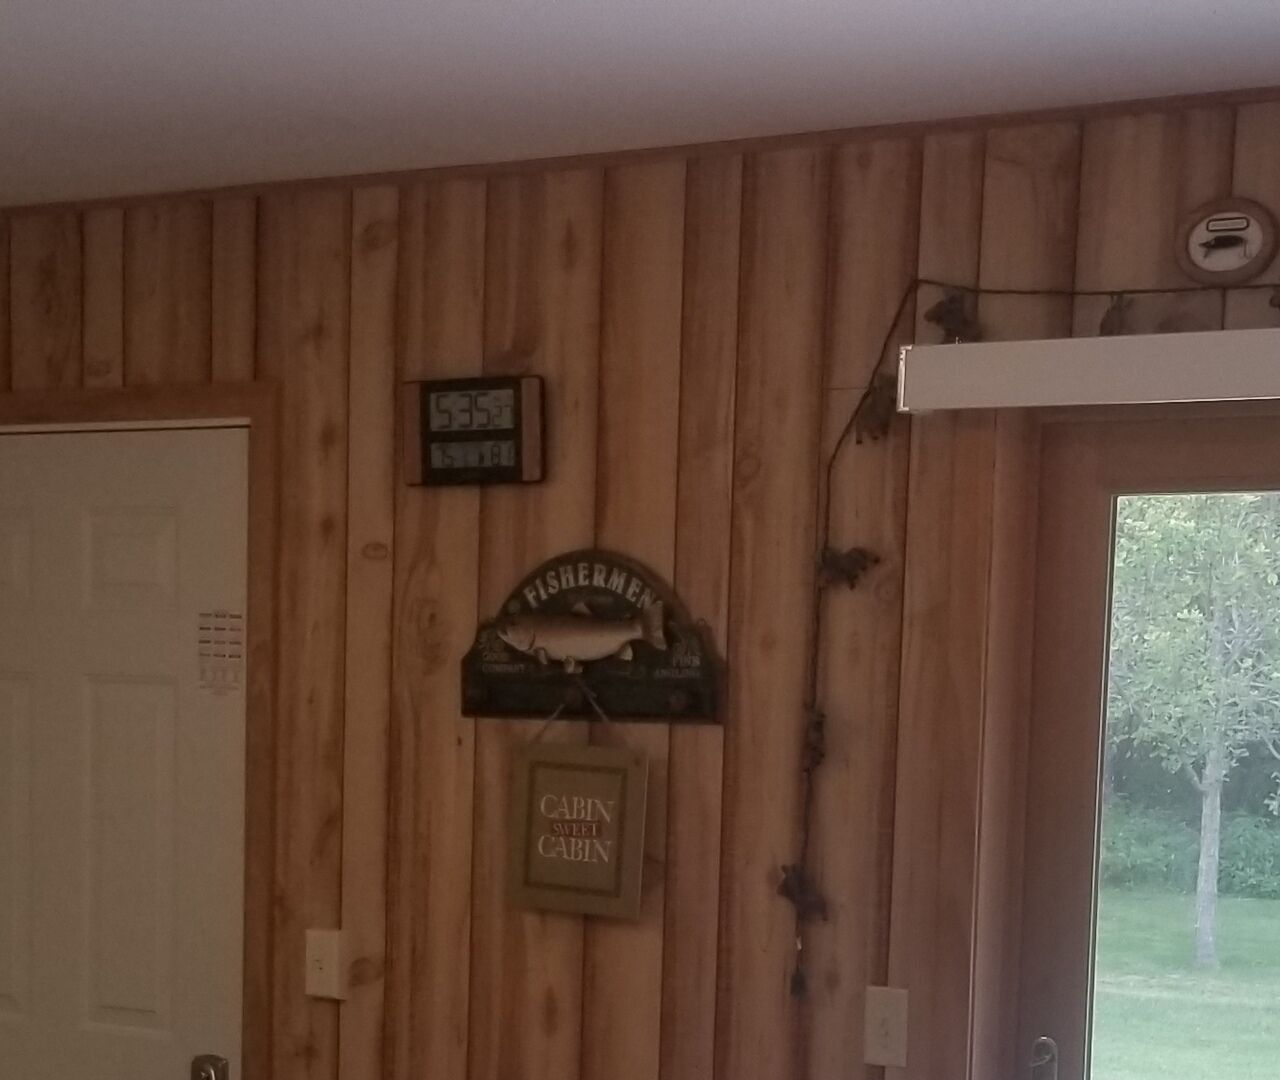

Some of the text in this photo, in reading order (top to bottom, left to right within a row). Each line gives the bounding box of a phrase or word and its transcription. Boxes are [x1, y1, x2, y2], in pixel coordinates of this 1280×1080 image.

[540, 794, 615, 823] CABIN
[552, 823, 599, 836] SWEET
[538, 834, 612, 863] CABIN
